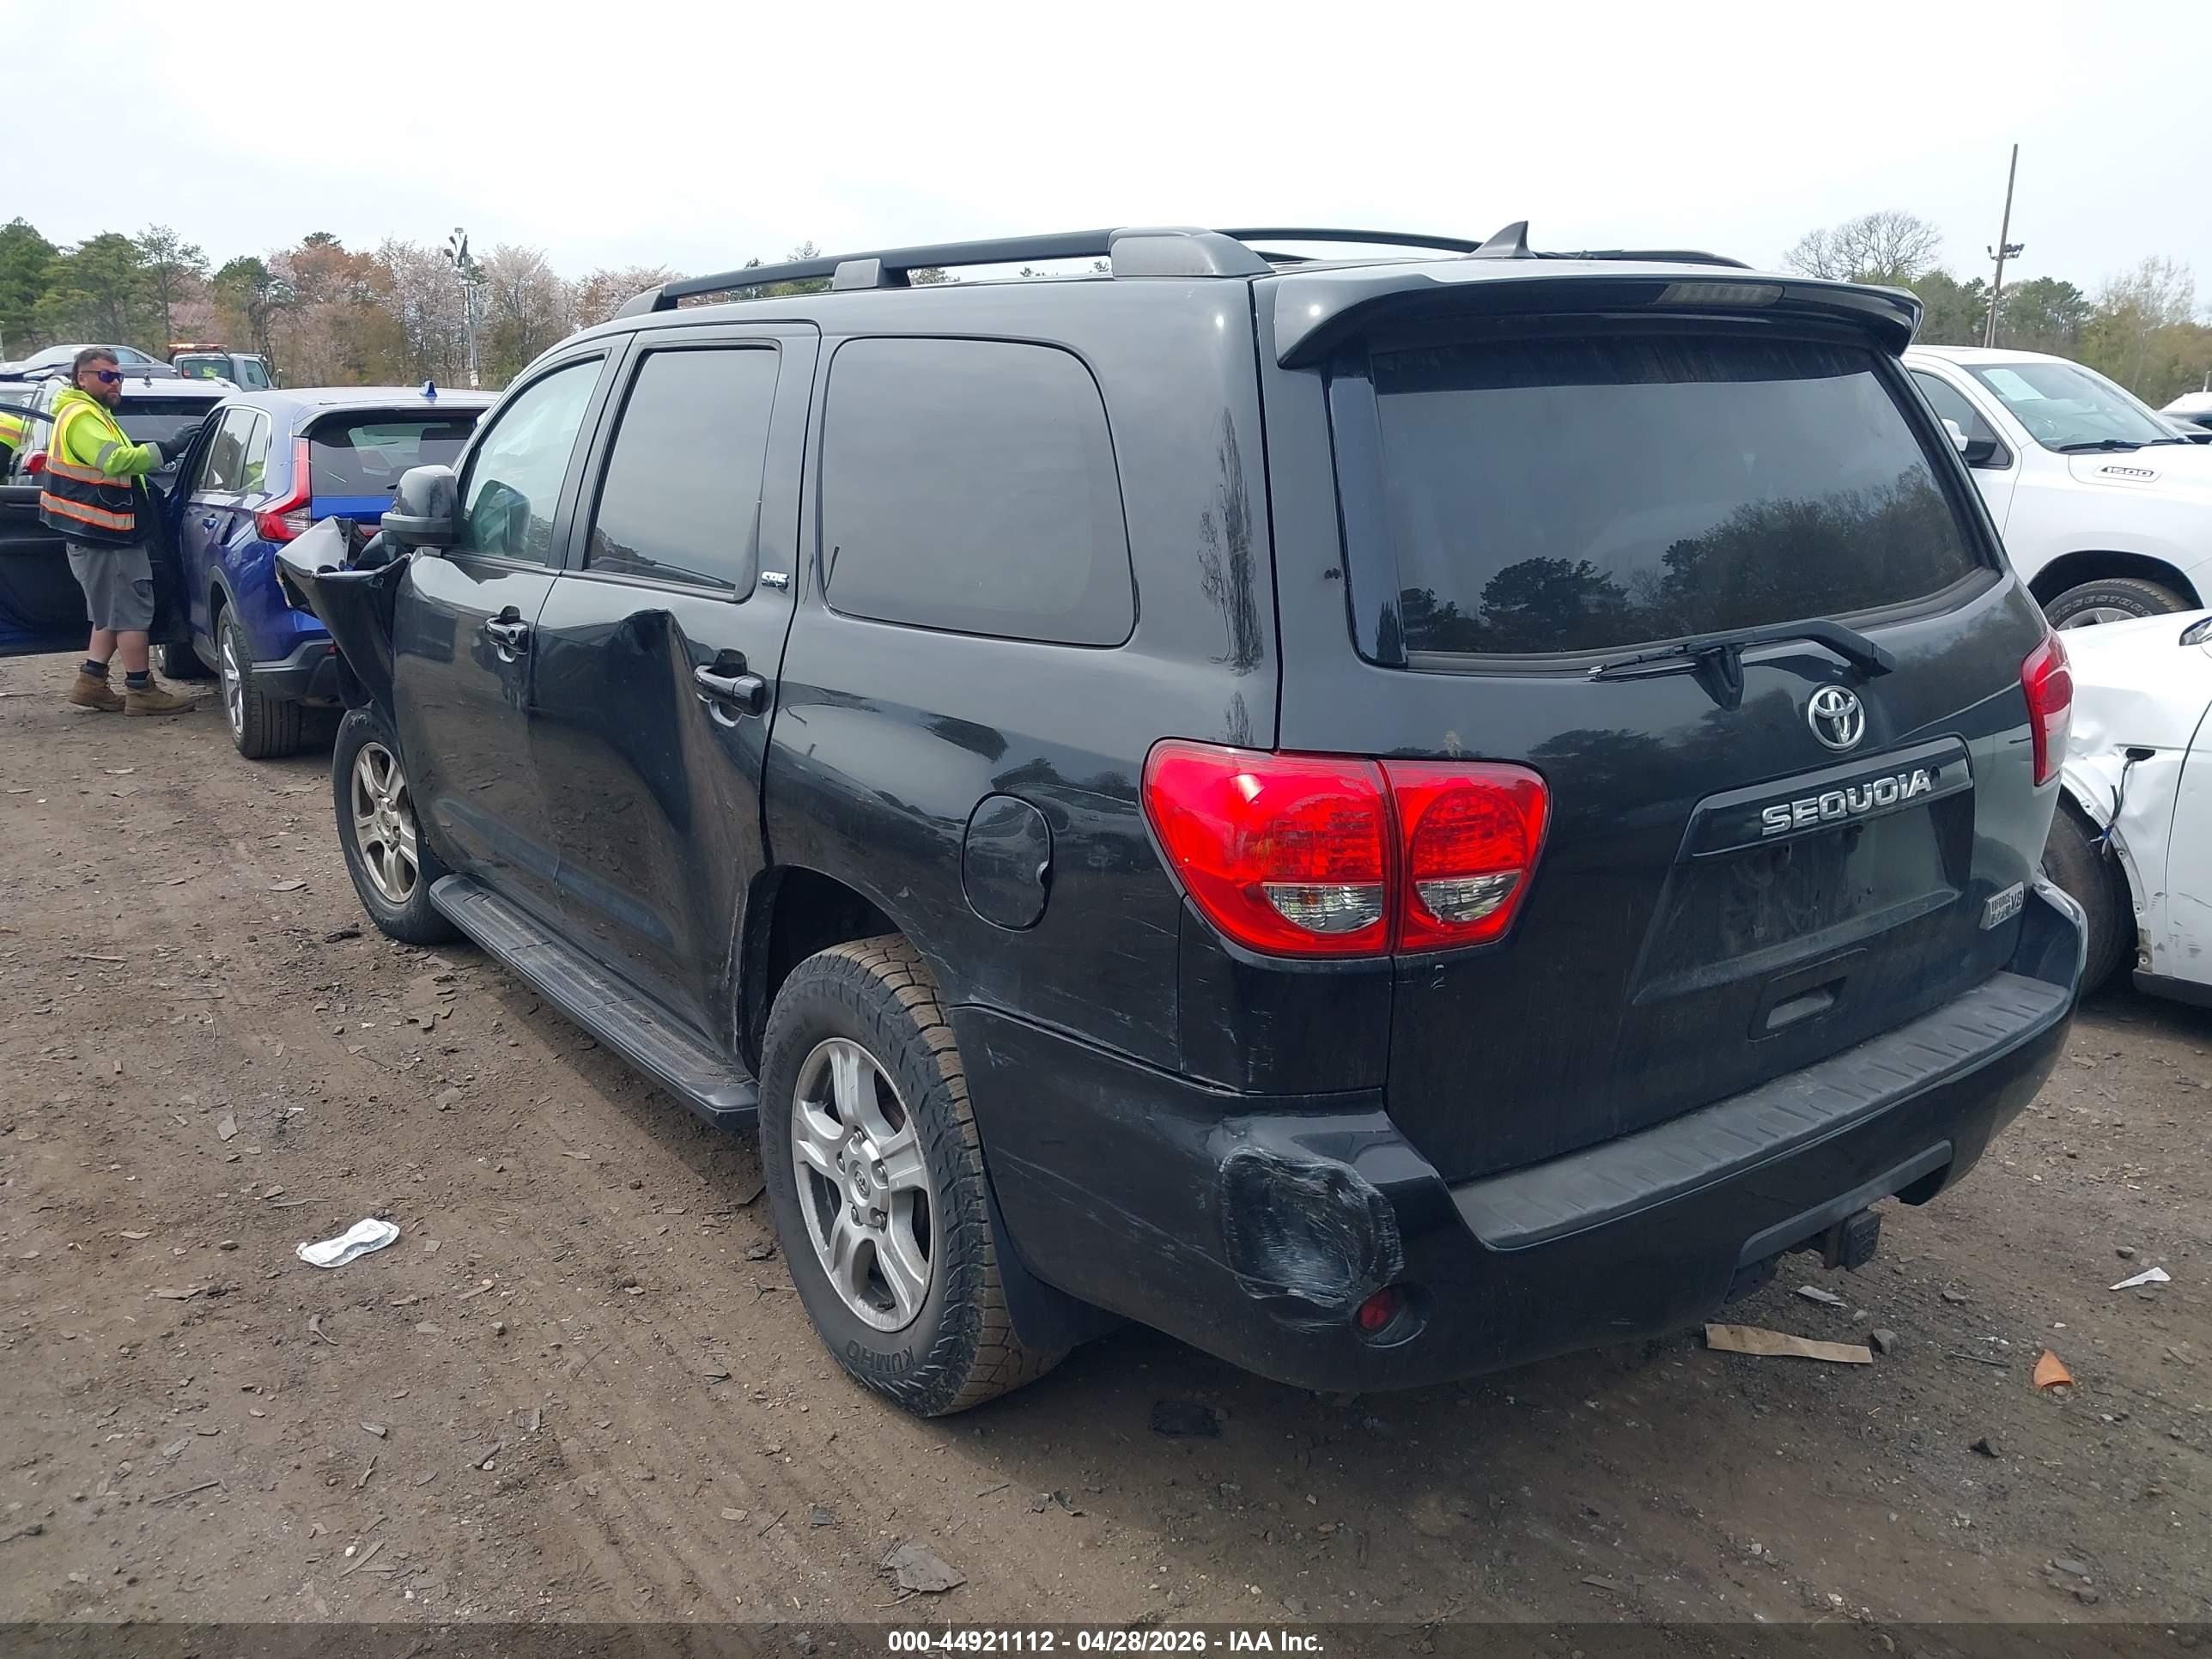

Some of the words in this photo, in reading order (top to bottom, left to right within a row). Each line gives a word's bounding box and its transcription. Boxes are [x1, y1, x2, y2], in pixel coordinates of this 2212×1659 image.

[2106, 466, 2152, 477] 1500
[1762, 769, 1932, 836] SEQUOIA
[846, 1340, 916, 1374] KUMHO
